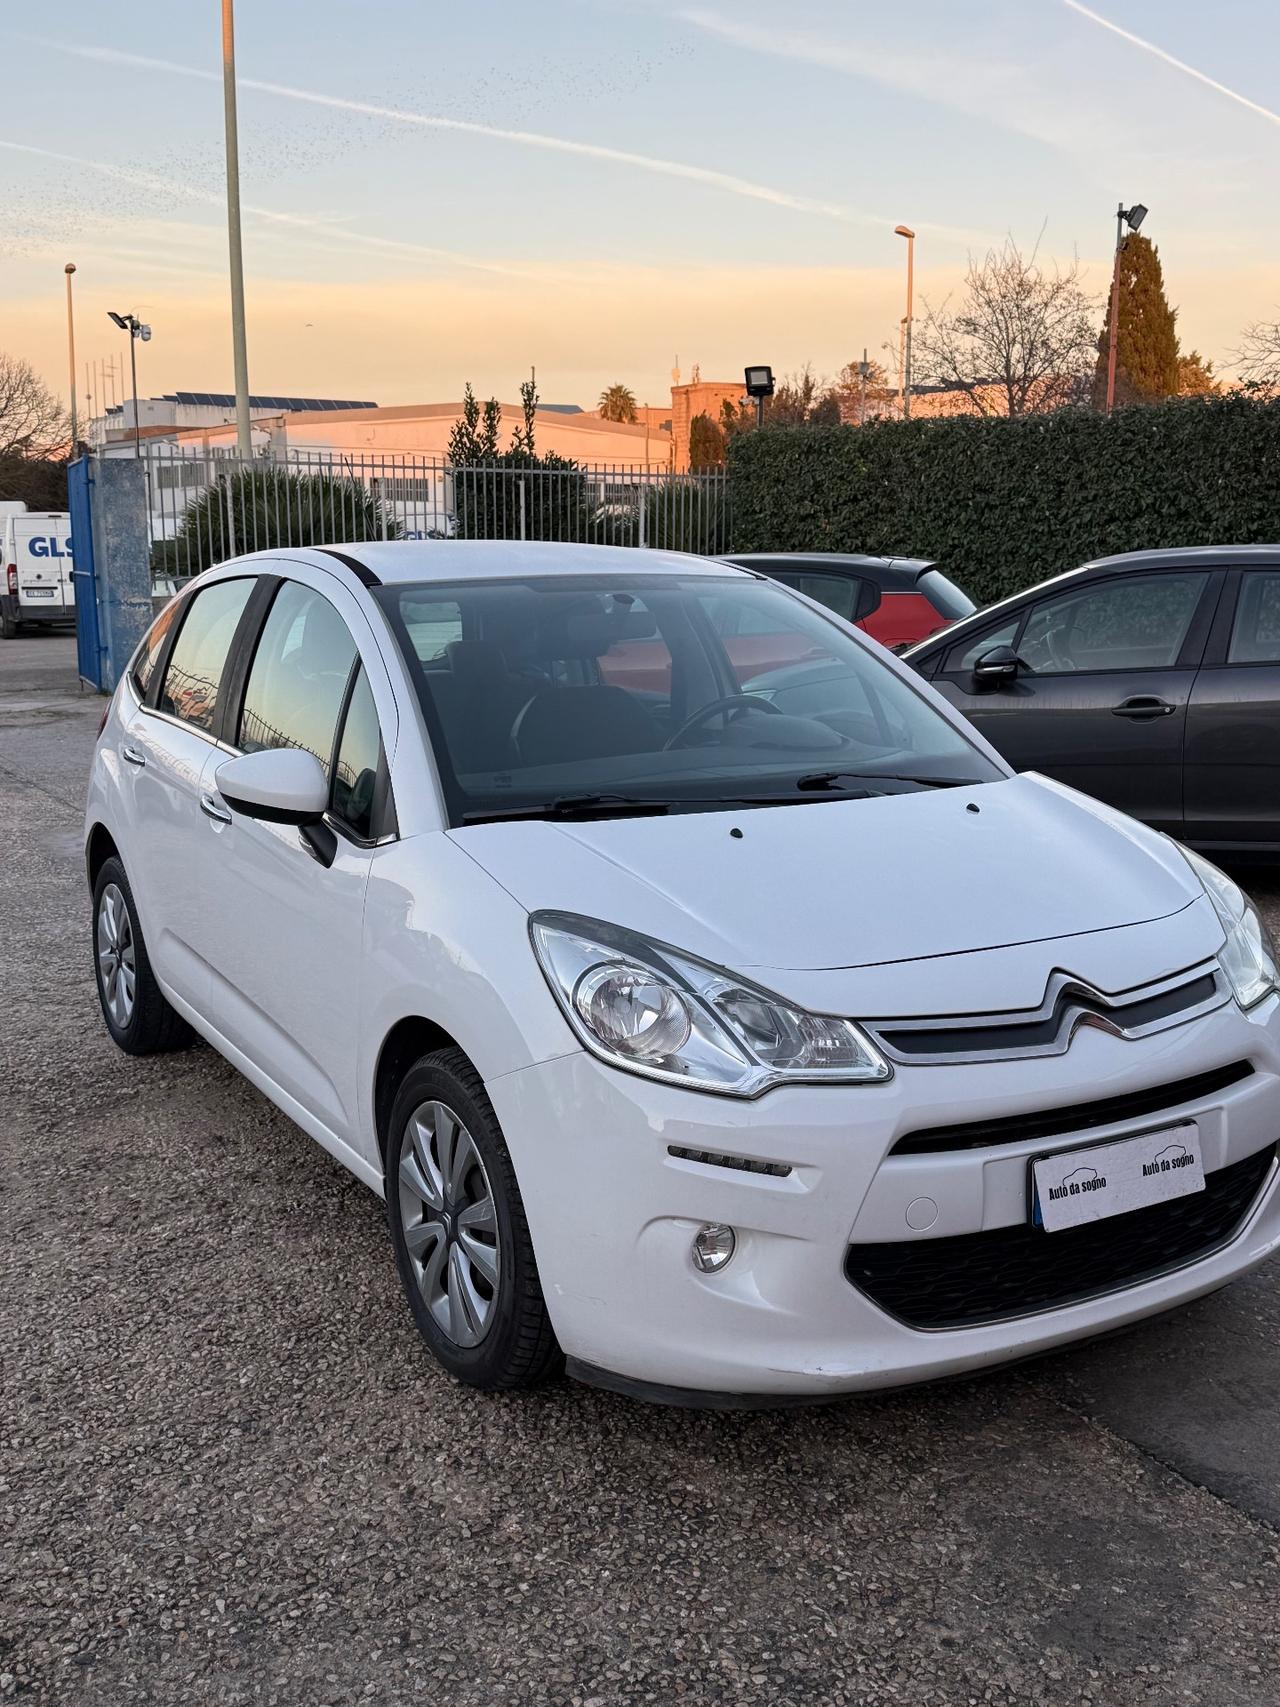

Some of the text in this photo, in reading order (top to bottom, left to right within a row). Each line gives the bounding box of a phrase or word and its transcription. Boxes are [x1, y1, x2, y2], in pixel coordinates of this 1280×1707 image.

[1142, 1154, 1195, 1177] Auto da sogno
[1049, 1177, 1107, 1201] Auto da sogno
